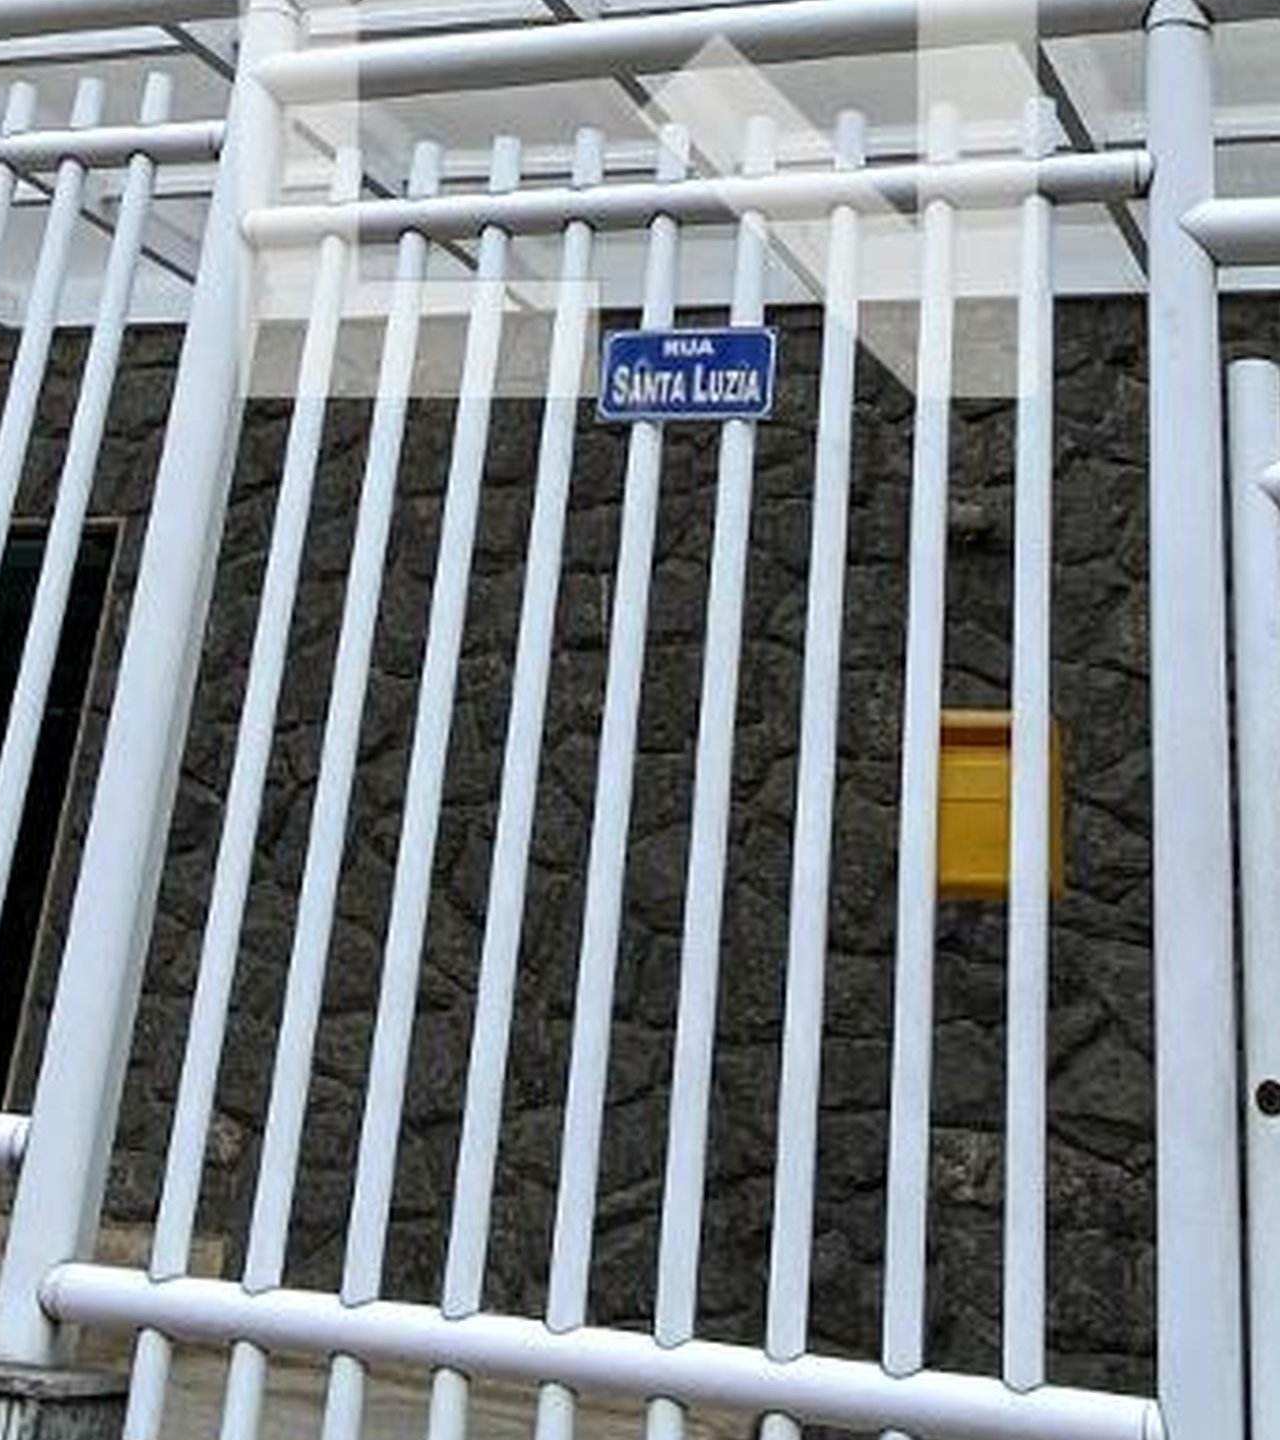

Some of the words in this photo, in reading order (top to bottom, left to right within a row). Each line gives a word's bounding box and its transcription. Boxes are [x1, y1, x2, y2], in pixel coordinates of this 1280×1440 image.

[662, 338, 715, 357] RUA
[612, 365, 686, 405] SANTA
[692, 363, 761, 403] LUZIA
